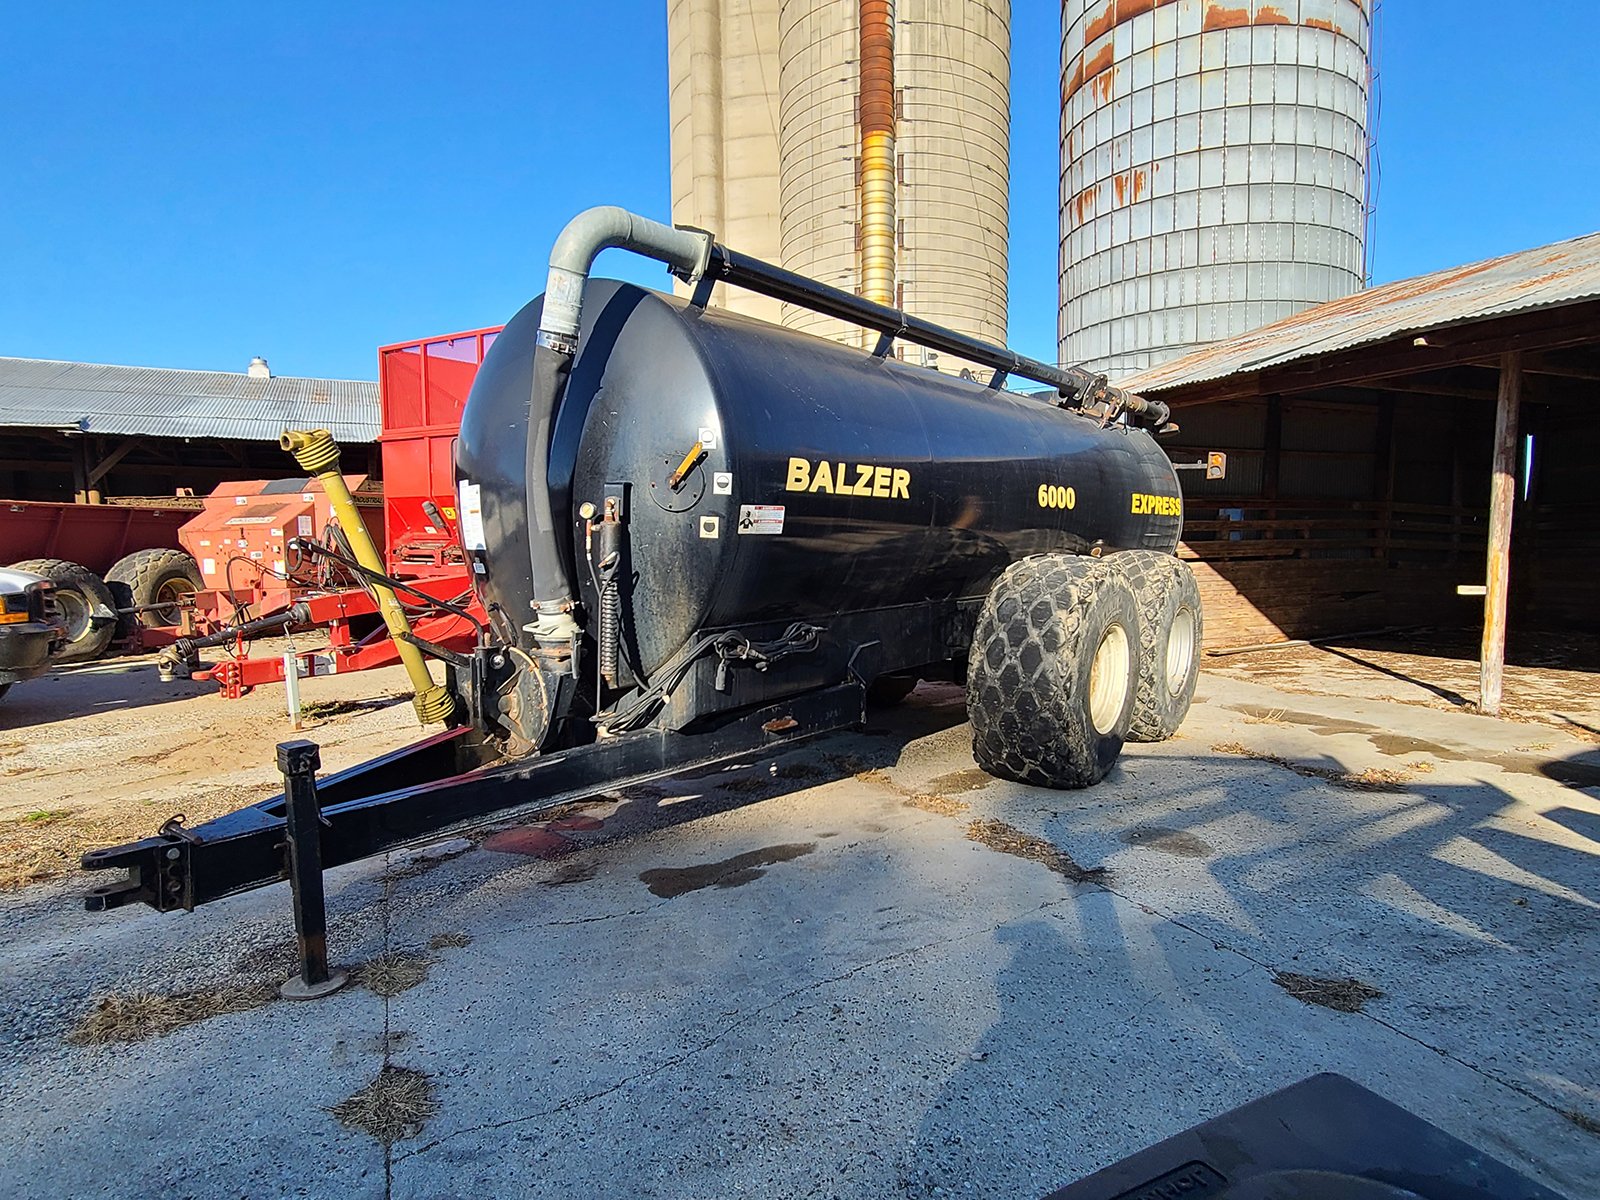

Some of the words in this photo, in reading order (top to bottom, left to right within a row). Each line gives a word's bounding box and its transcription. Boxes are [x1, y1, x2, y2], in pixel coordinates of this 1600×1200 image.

[785, 457, 911, 499] BALZER
[1038, 484, 1076, 510] 6000
[1131, 493, 1181, 517] EXPRESS
